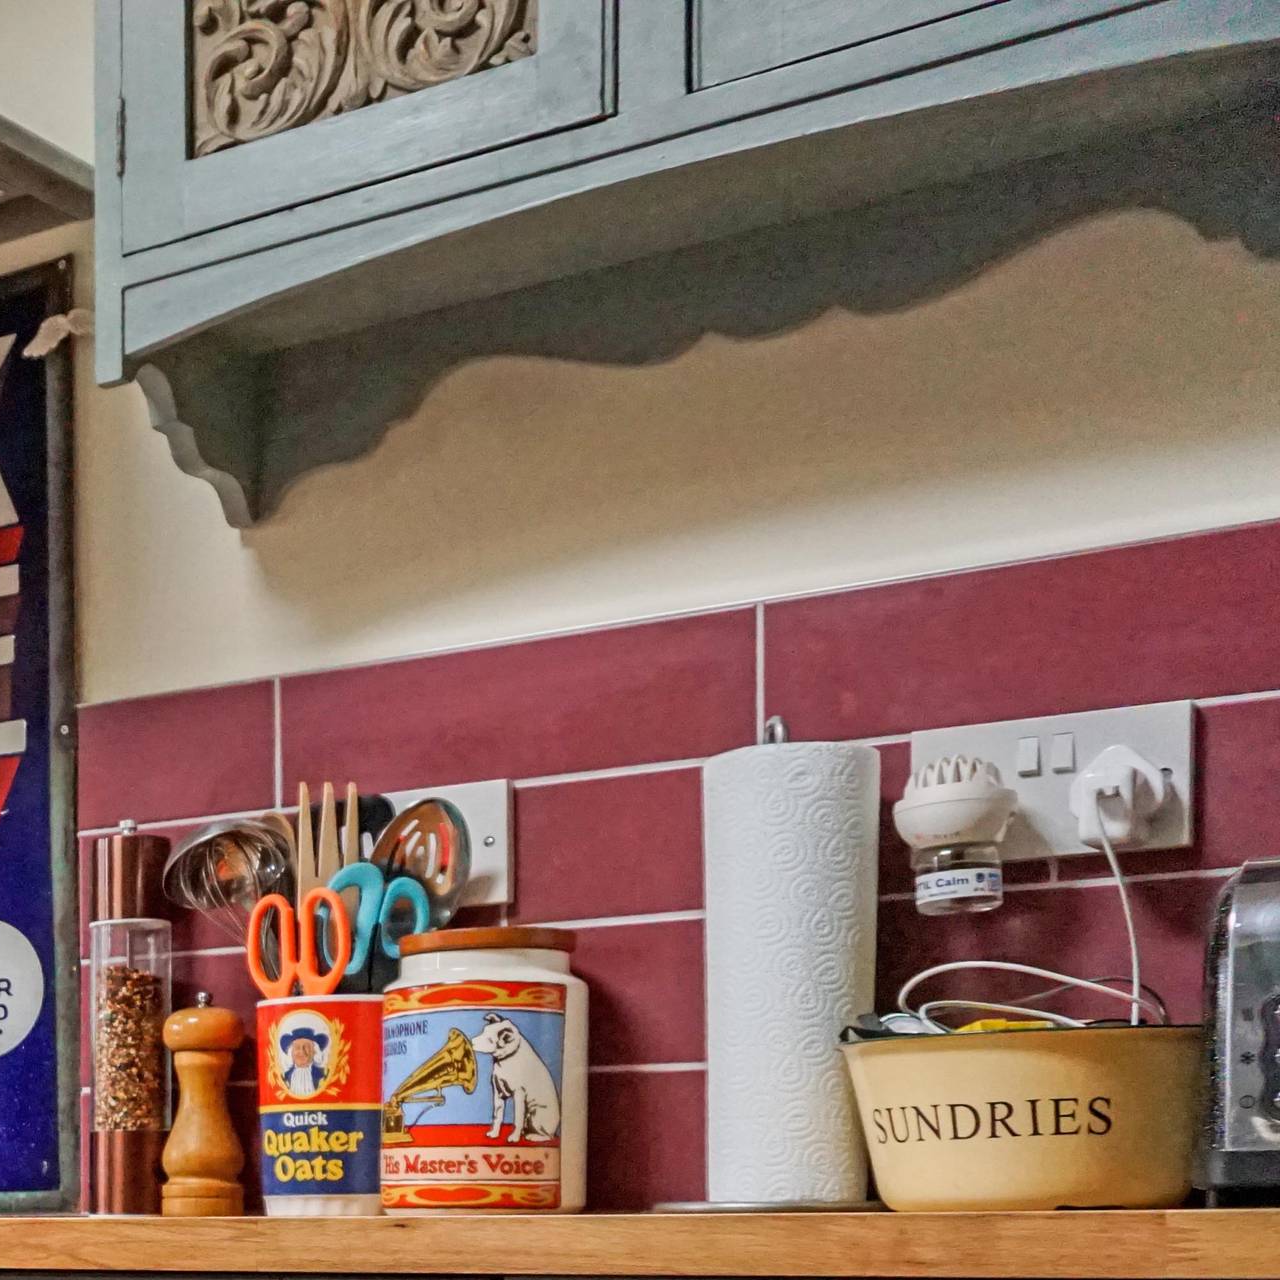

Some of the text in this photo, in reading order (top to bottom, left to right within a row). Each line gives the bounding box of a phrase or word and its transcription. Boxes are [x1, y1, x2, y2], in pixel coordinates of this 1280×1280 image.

[935, 876, 970, 888] Calm
[283, 1111, 329, 1128] Quick
[872, 1096, 1114, 1145] SUNDRIES
[263, 1126, 365, 1158] Quaker
[274, 1155, 345, 1182] Oats
[404, 1154, 478, 1175] Master's
